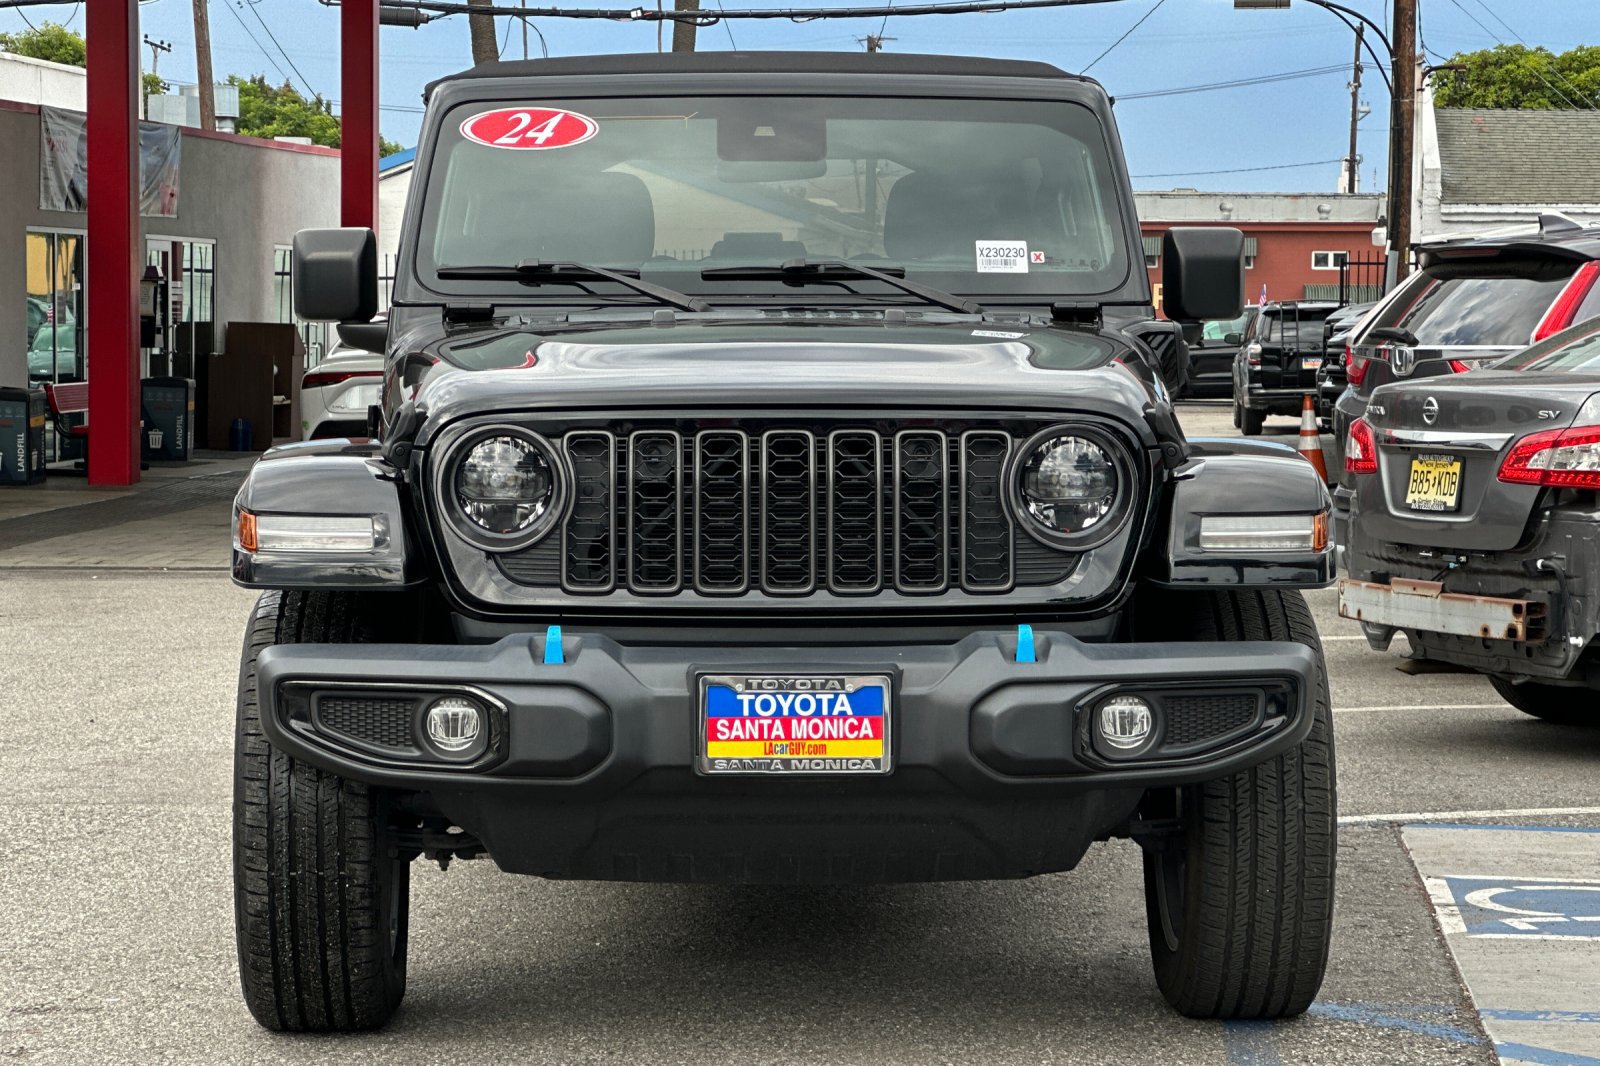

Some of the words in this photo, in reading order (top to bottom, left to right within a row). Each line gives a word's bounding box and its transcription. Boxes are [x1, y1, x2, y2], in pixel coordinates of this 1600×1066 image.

[494, 112, 565, 145] 24
[978, 246, 1026, 258] X230230
[1537, 409, 1562, 420] SV
[175, 415, 183, 449] LANDFILL
[17, 433, 25, 472] LANDFILL
[1410, 469, 1431, 495] B85
[1436, 471, 1457, 497] KDB
[747, 678, 842, 690] TOYOTA
[736, 693, 854, 717] TOYOTA
[716, 718, 785, 740] SANTA
[791, 717, 874, 740] MONICA
[763, 742, 827, 756] LAcarGUY.com
[714, 759, 784, 771] SANTA
[790, 759, 876, 771] MONICA
